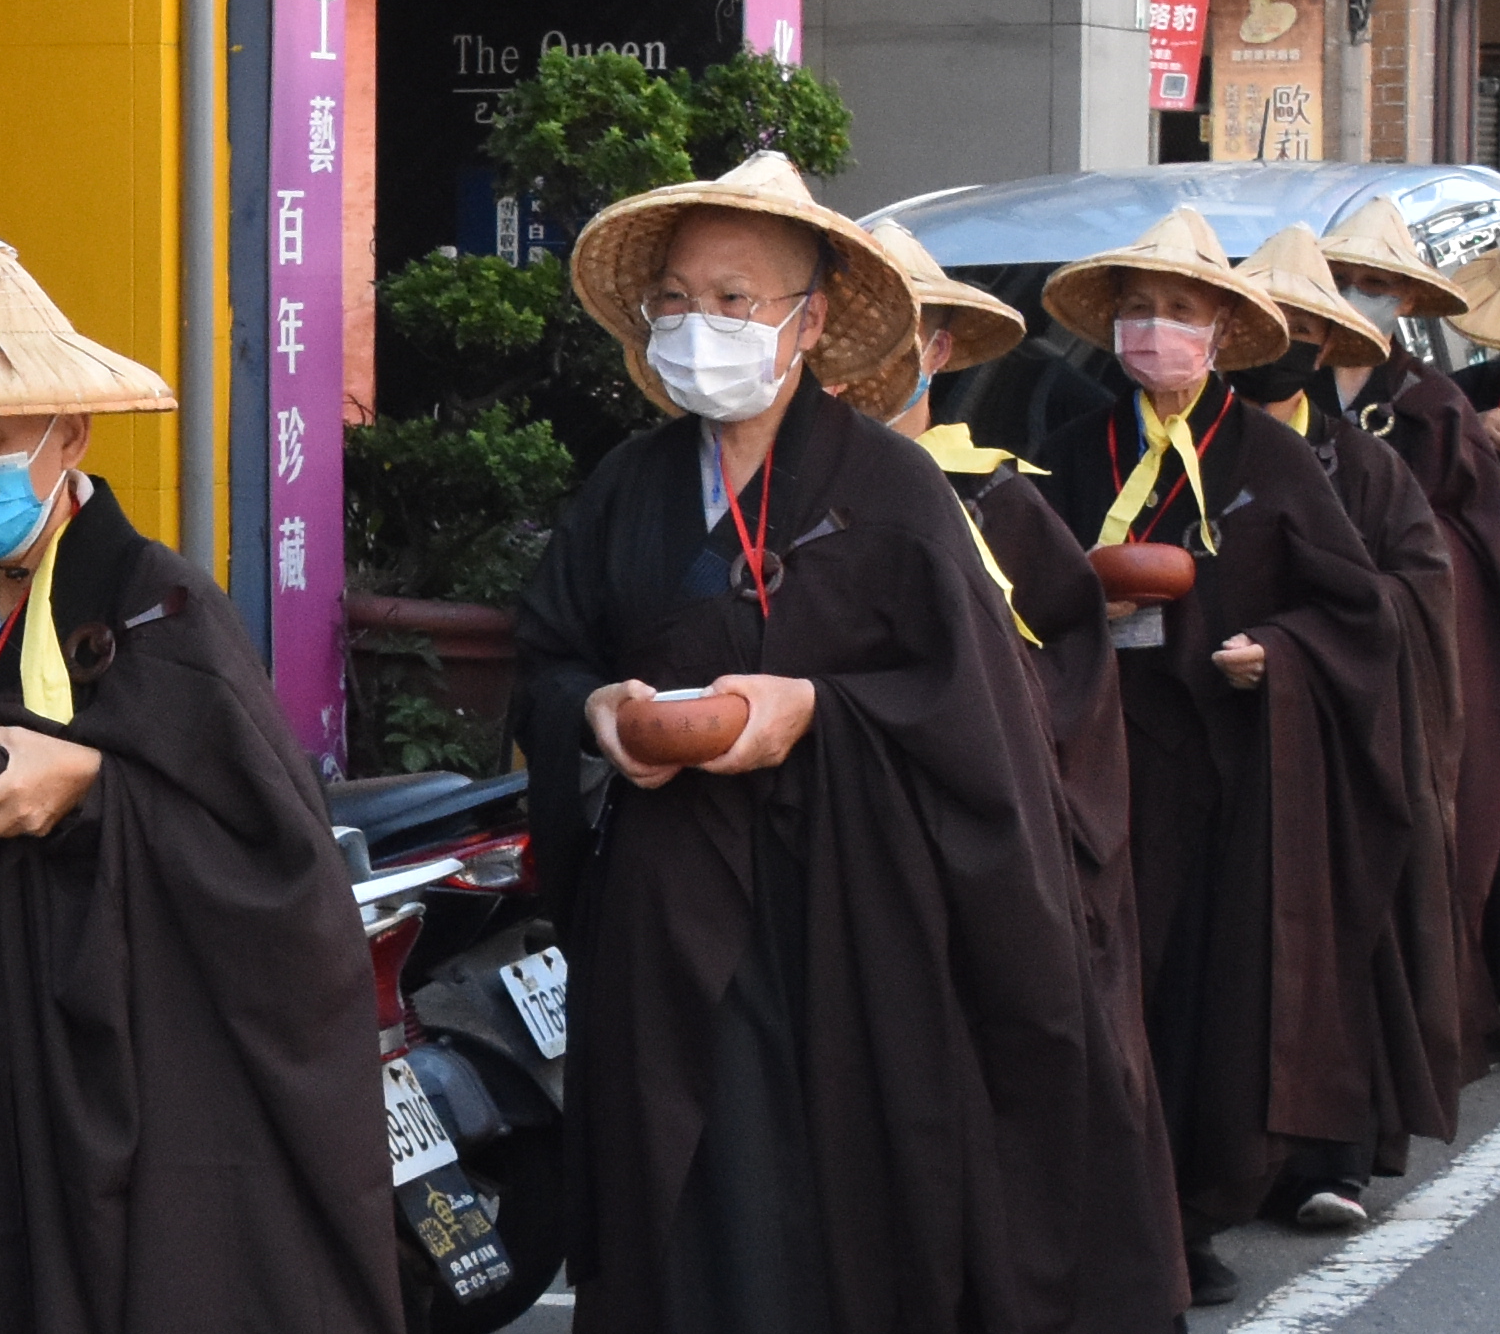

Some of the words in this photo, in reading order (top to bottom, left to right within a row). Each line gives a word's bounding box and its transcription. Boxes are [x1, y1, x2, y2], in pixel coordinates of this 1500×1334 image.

[454, 35, 519, 74] The
[275, 190, 306, 593] 百年珍藏
